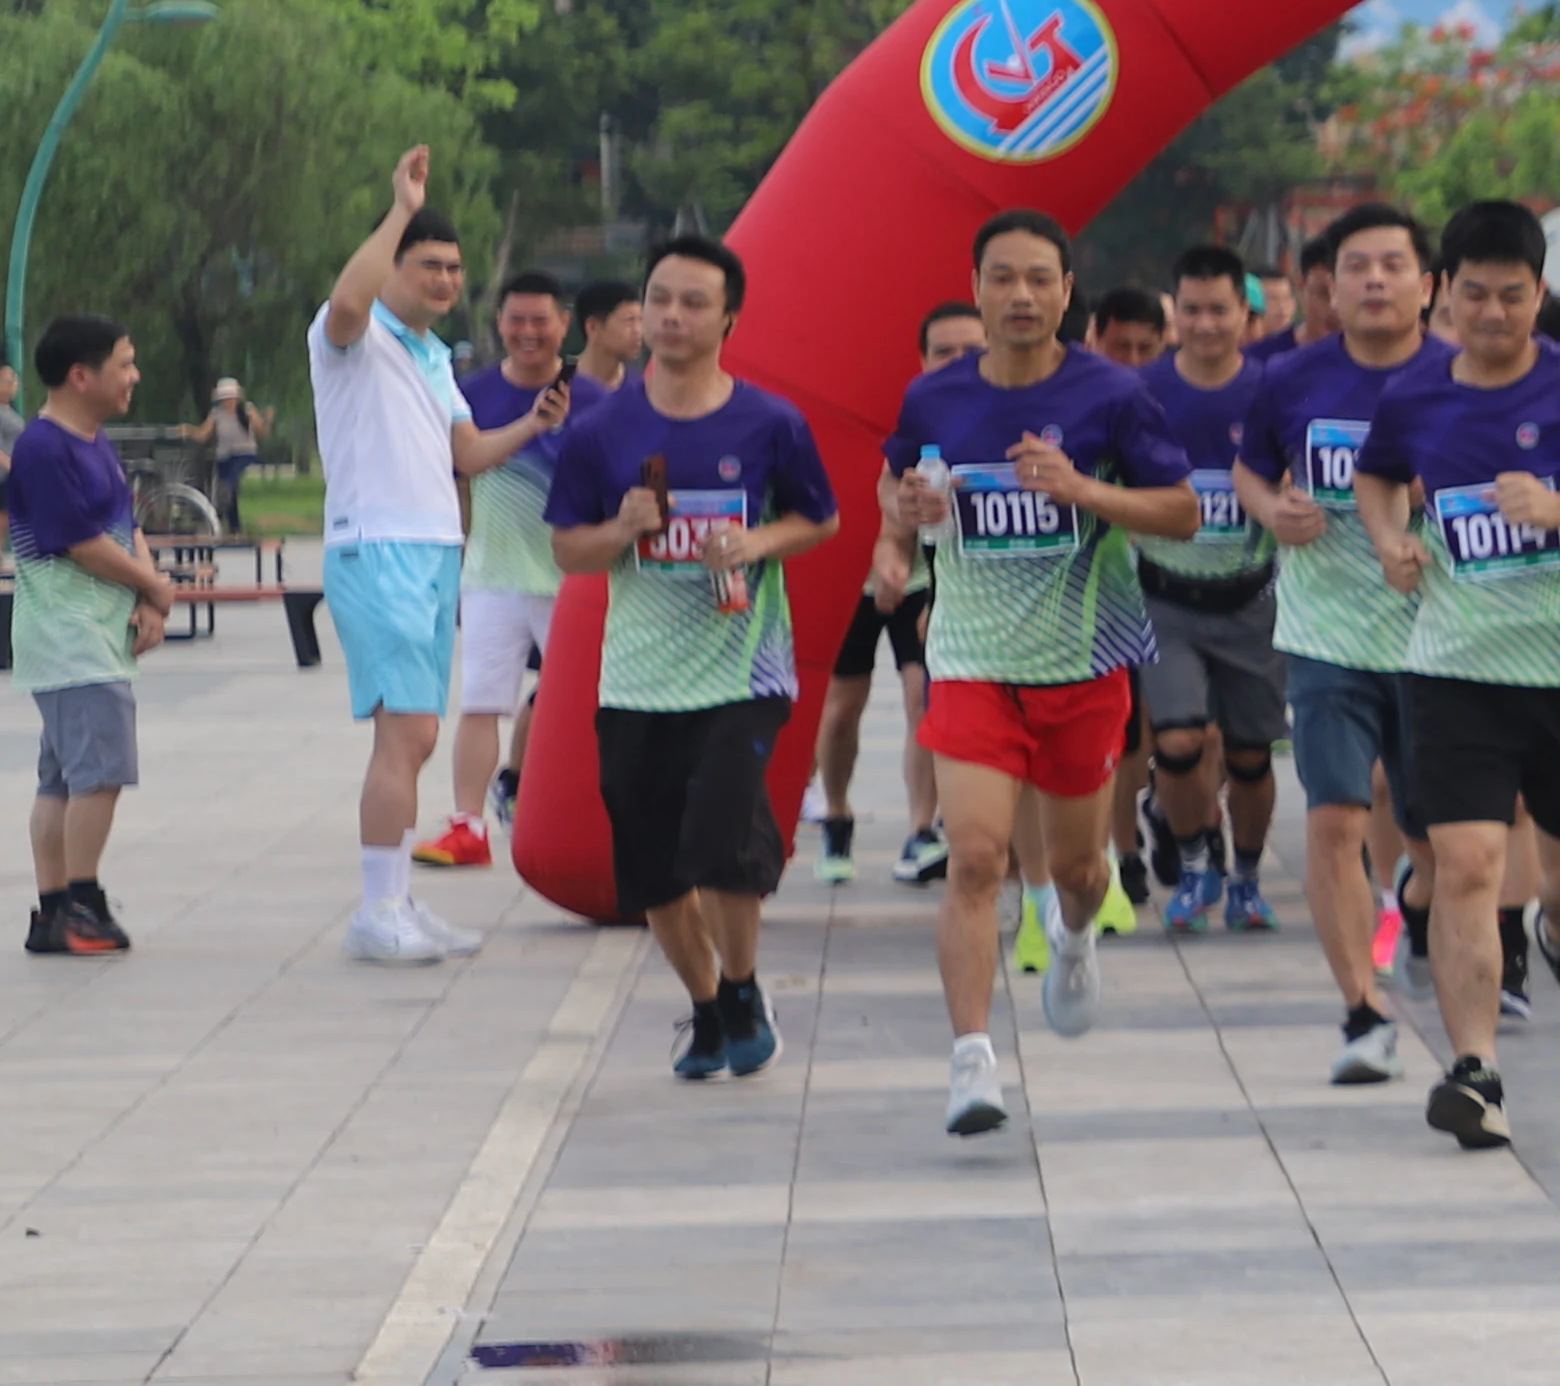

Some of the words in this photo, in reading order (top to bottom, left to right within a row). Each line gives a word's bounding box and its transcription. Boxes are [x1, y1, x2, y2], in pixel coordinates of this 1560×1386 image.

[1318, 445, 1360, 490] 10
[970, 490, 1060, 538] 10115
[1200, 490, 1239, 527] 121
